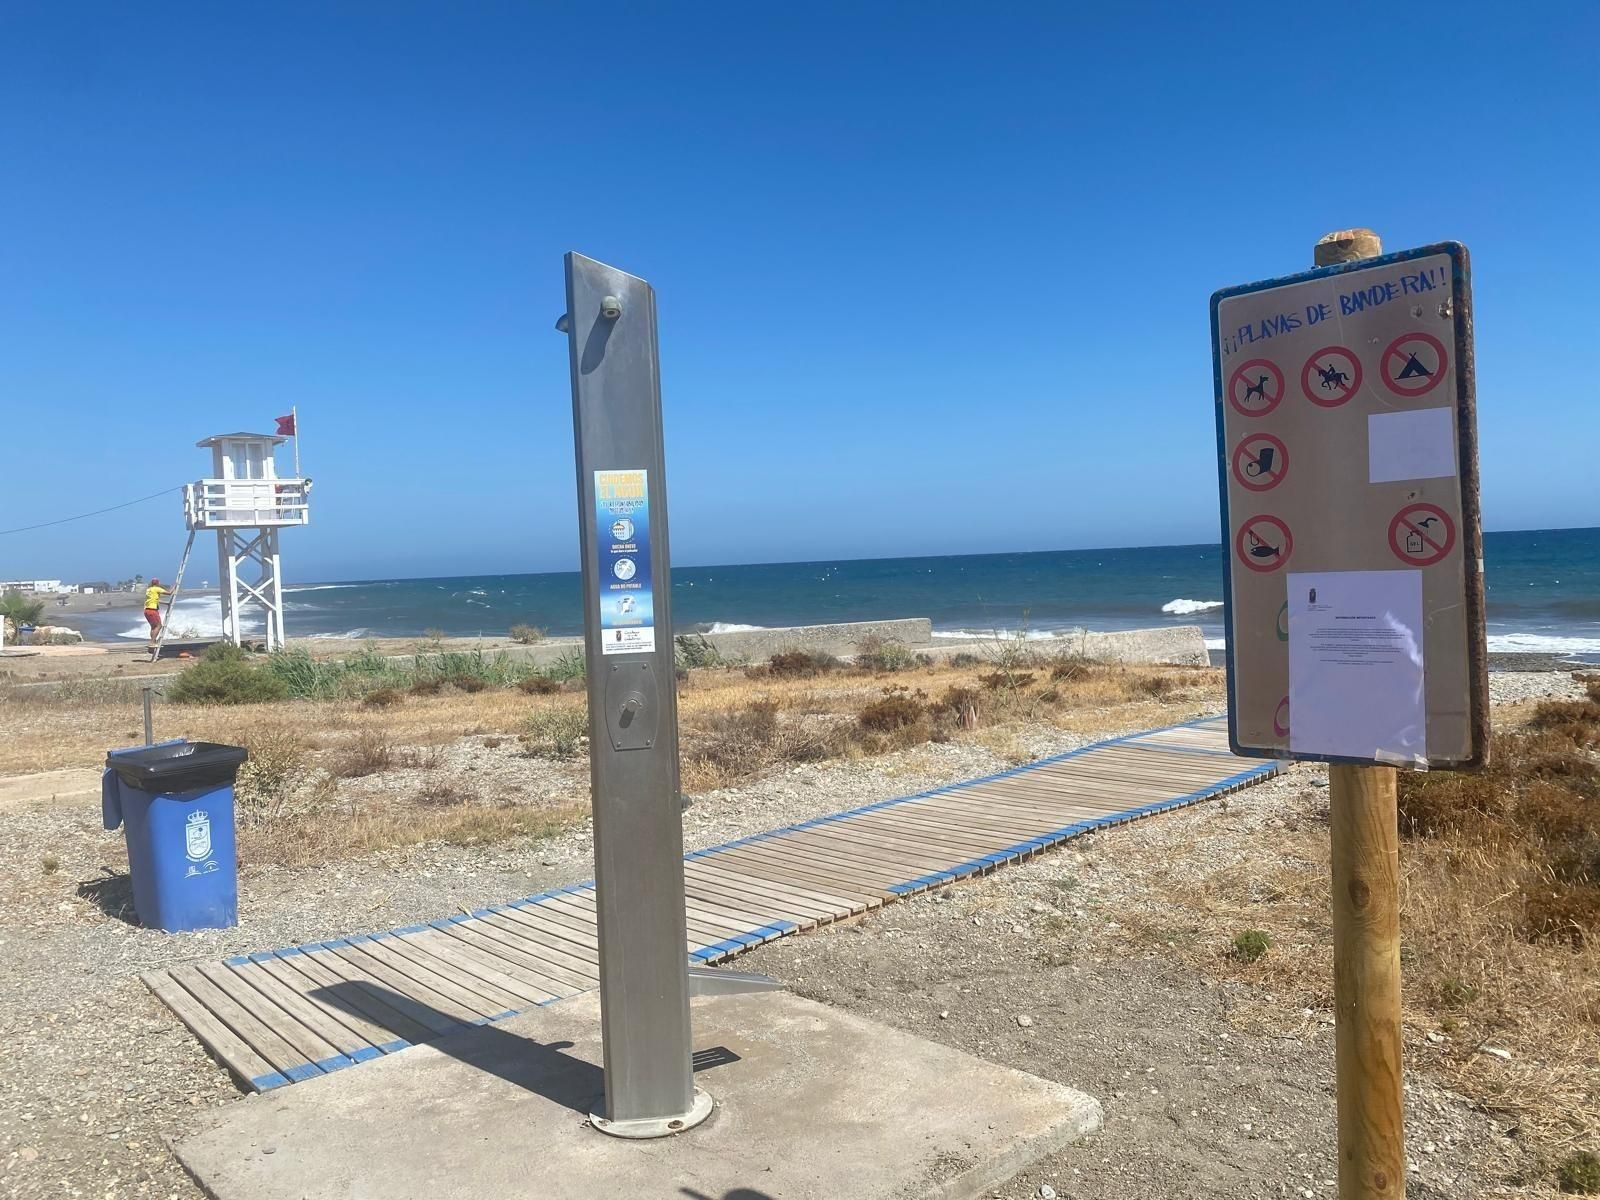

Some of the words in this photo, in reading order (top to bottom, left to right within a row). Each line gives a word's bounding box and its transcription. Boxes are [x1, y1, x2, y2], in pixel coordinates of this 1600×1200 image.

[1306, 303, 1332, 325] DE
[1338, 266, 1447, 316] BANDERA!!
[599, 473, 643, 484] CUIDEMOS
